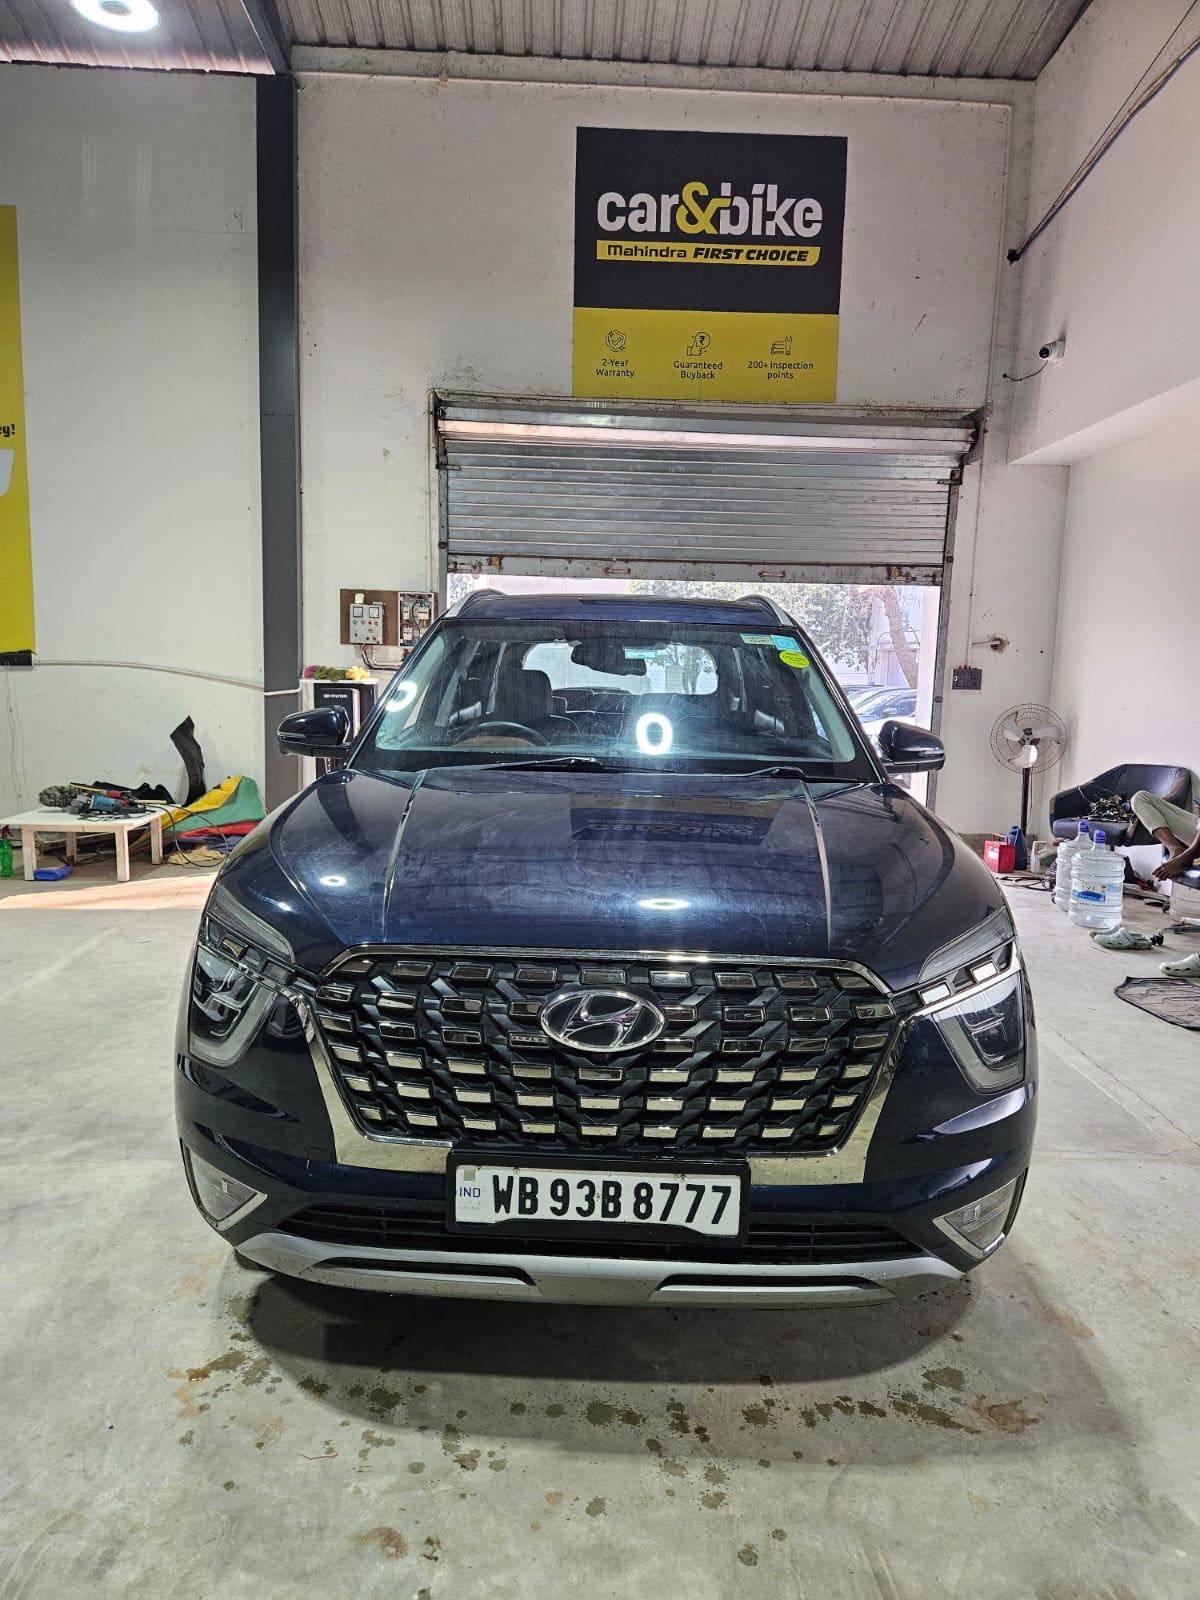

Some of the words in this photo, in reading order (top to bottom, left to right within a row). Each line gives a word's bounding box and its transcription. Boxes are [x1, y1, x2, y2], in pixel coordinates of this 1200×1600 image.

[597, 181, 823, 238] car&bike
[607, 244, 687, 258] Mahindra
[693, 247, 743, 260] FIRST
[745, 249, 809, 262] CHOICE
[601, 358, 629, 367] 2-Year
[673, 360, 723, 370] Guaranteed
[748, 361, 768, 369] 200+
[595, 368, 635, 379] Warranty
[680, 370, 716, 380] Buyback
[767, 371, 794, 380] points
[459, 1186, 481, 1198] IND
[492, 1175, 539, 1215] WB
[632, 1182, 732, 1225] 8777
